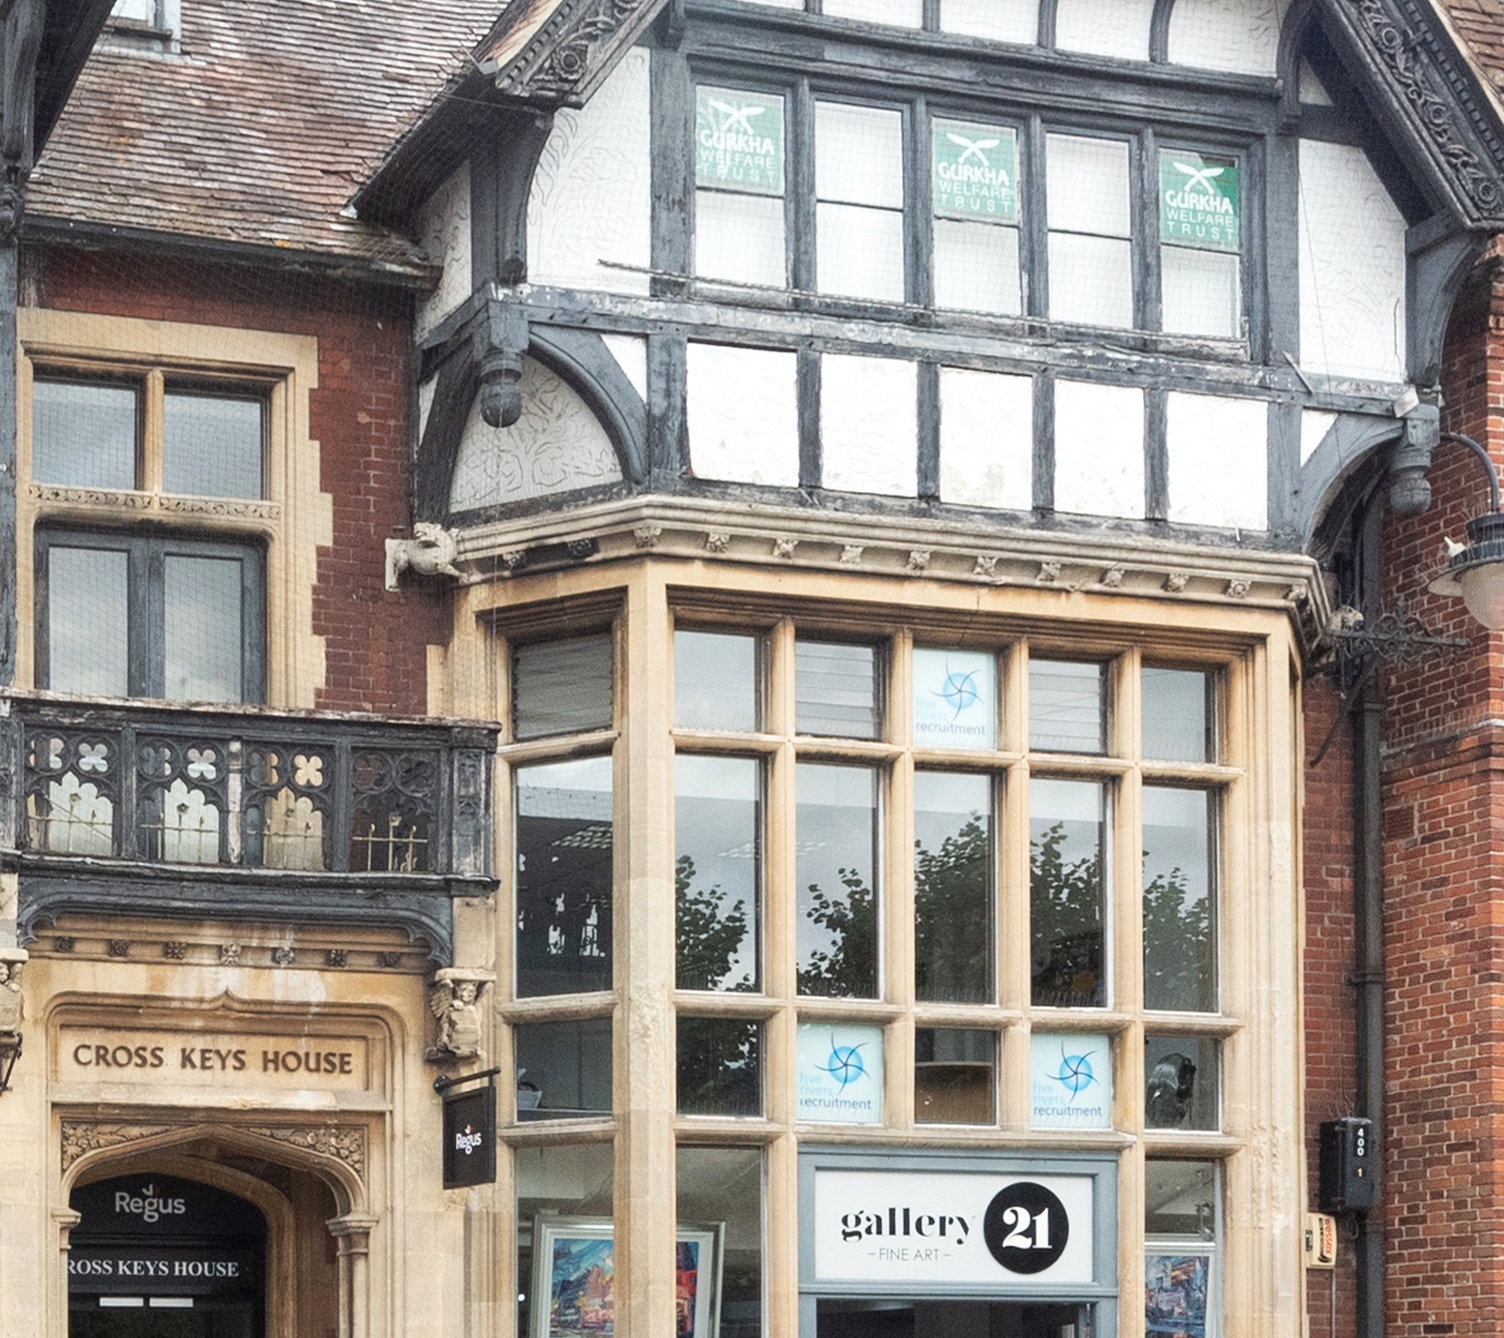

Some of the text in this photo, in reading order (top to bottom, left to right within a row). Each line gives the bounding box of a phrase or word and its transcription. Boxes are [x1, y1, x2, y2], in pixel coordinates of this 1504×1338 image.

[700, 129, 775, 155] GURKHA
[700, 149, 775, 170] WELFARE
[701, 164, 776, 183] TRUST
[938, 162, 1010, 187] GURKHA
[939, 179, 1010, 200] WELFARE
[940, 193, 1011, 213] TRUST
[1165, 189, 1234, 215] GURKHA
[1166, 207, 1234, 228] WELFARE
[1166, 221, 1235, 241] TRUST
[915, 721, 986, 736] recruitment
[73, 1044, 353, 1074] CROSS KEYS HOUSE
[799, 1072, 823, 1086] five
[1032, 1081, 1055, 1094] five
[799, 1095, 872, 1110] recruitment
[1033, 1104, 1102, 1117] recruitment
[455, 1126, 482, 1155] Regus
[114, 1185, 186, 1223] Regus
[841, 1206, 1053, 1250] gallery 21
[879, 1248, 940, 1262] FINE ART
[68, 1260, 240, 1277] ROSS KEYS HOUSE
